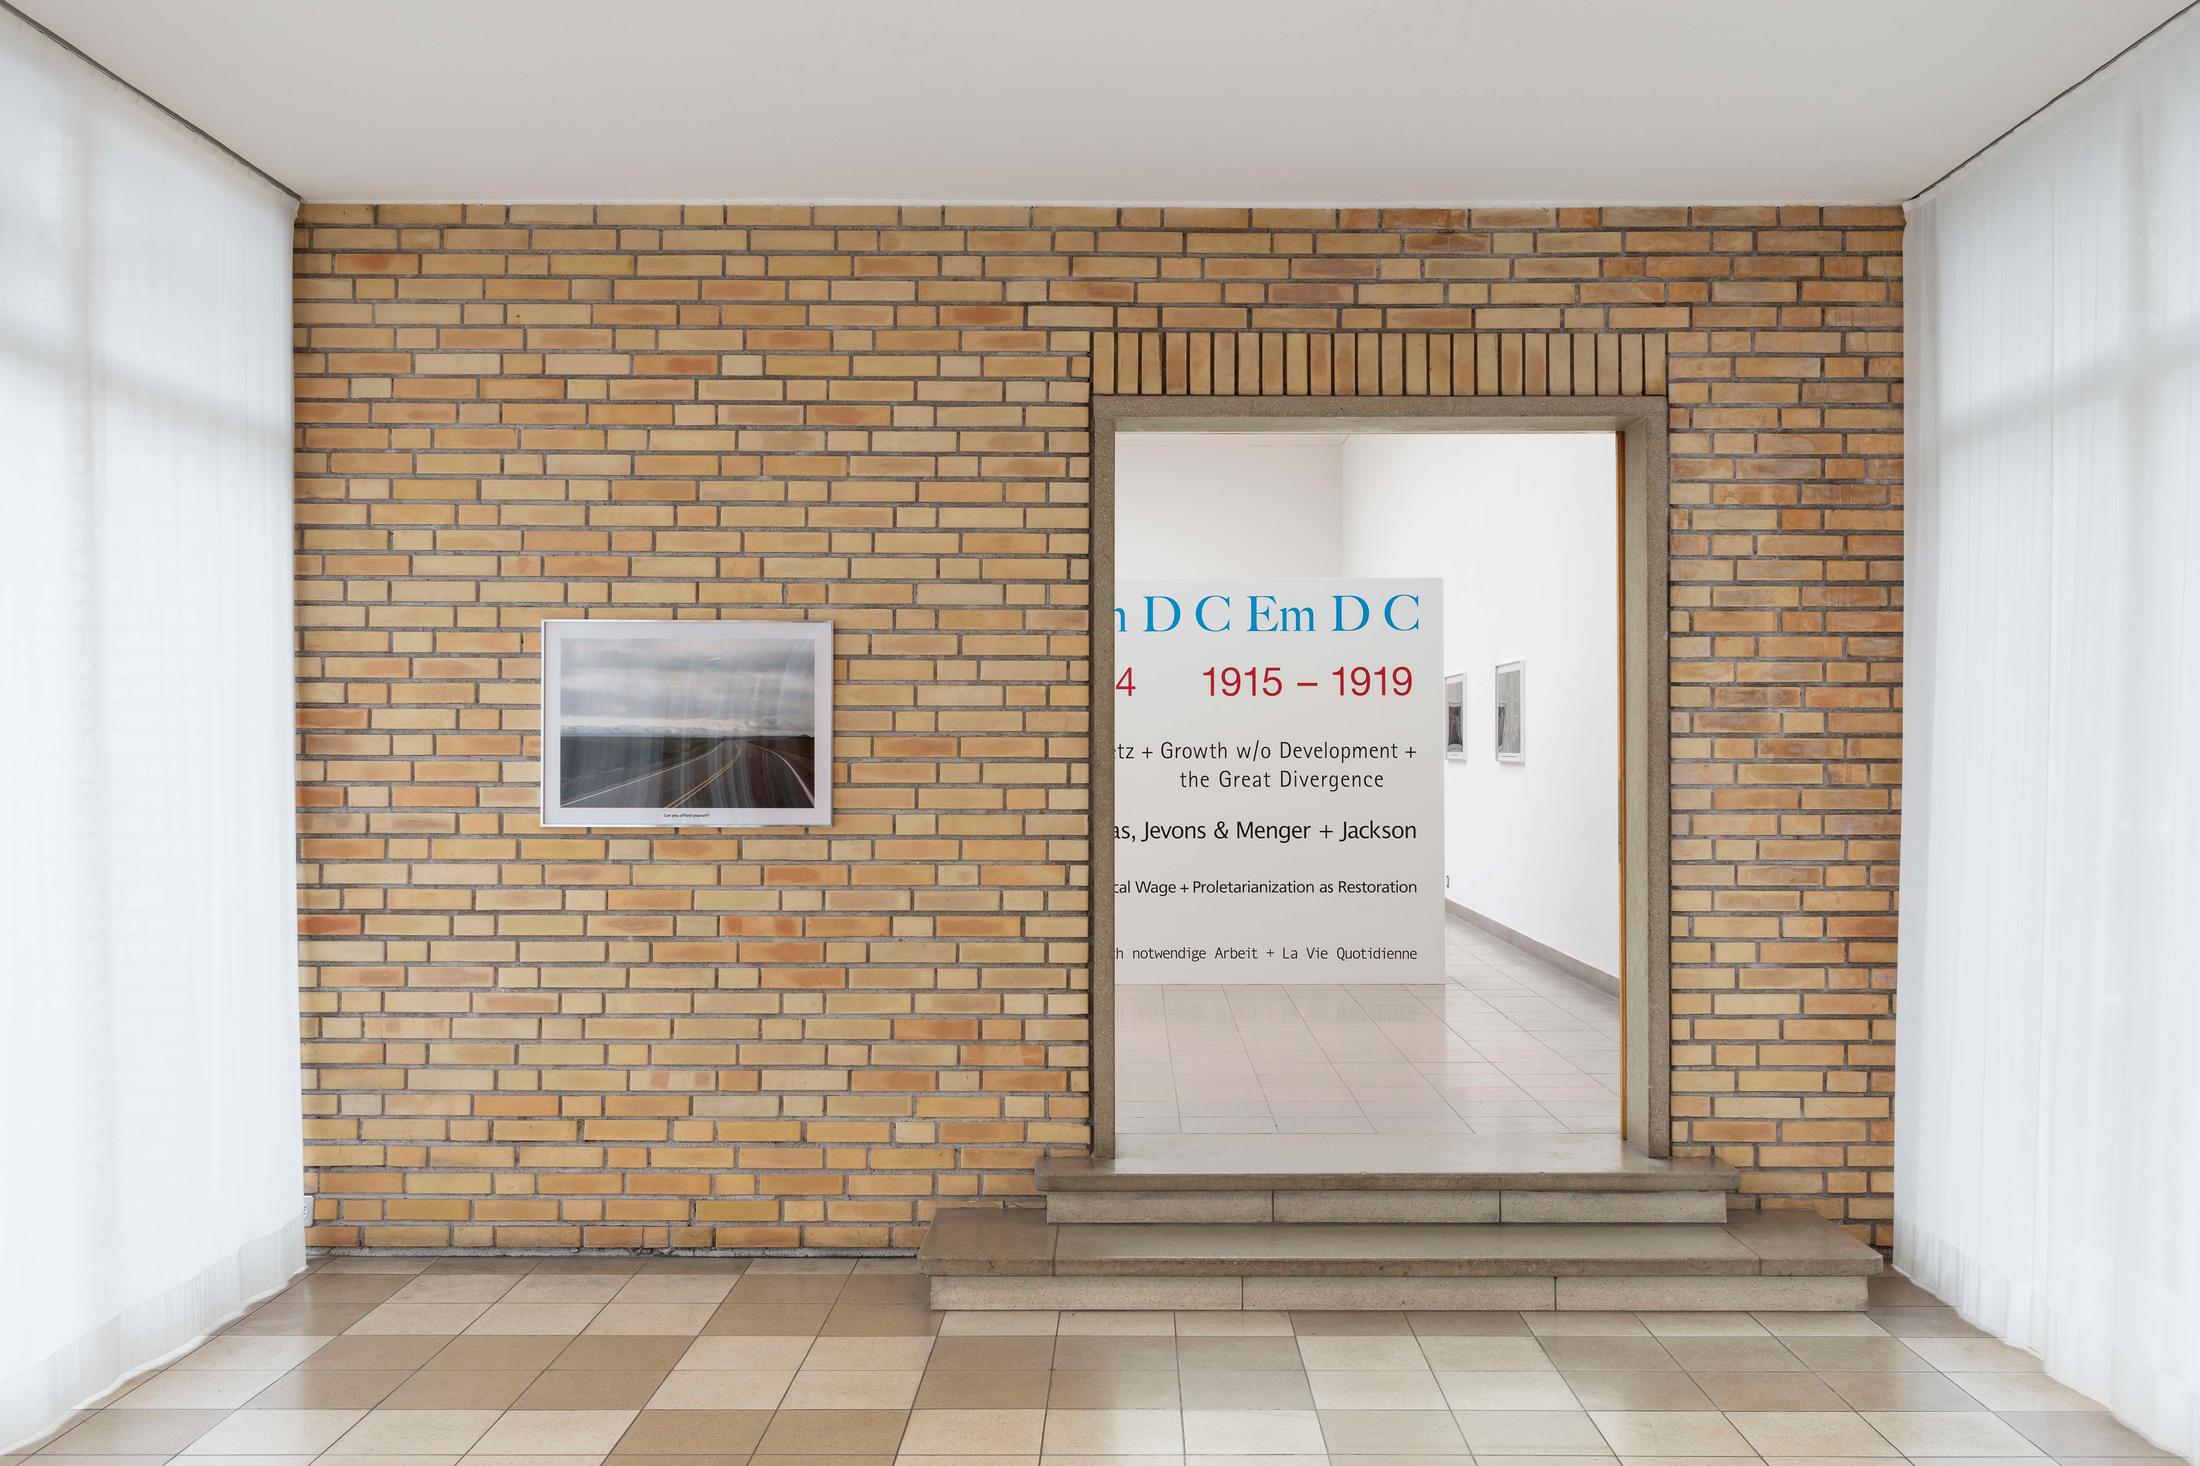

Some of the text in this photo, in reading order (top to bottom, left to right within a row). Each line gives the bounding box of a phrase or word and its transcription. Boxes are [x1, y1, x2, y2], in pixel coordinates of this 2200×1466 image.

[1144, 596, 1181, 632] D
[1195, 595, 1230, 632] C
[1247, 596, 1316, 632] Em
[1332, 595, 1369, 632] D
[1384, 594, 1419, 632] C
[1203, 666, 1282, 696] 1915
[1333, 666, 1412, 696] 1919
[1142, 746, 1154, 759] +
[1161, 742, 1228, 760] Growth
[1237, 740, 1271, 761] w/o
[1281, 742, 1398, 764] Development
[1405, 746, 1417, 758] +
[1180, 770, 1384, 792] the Great Divergence
[1140, 822, 1206, 842] Jevons
[1214, 821, 1229, 840] &
[1237, 821, 1311, 843] Menger
[1319, 825, 1334, 839] +
[1339, 820, 1417, 842] Jackson
[1135, 881, 1176, 897] Wage
[1180, 884, 1189, 894] +
[1193, 879, 1314, 894] Proletarianization
[1319, 883, 1334, 894] as
[1339, 880, 1418, 894] Restoration
[1133, 947, 1206, 963] notwendige
[1215, 947, 1258, 960] Arbeit
[1266, 948, 1275, 958] +
[1283, 947, 1298, 960] La
[1306, 947, 1329, 960] Vie
[1337, 947, 1418, 962] Quotidienne
